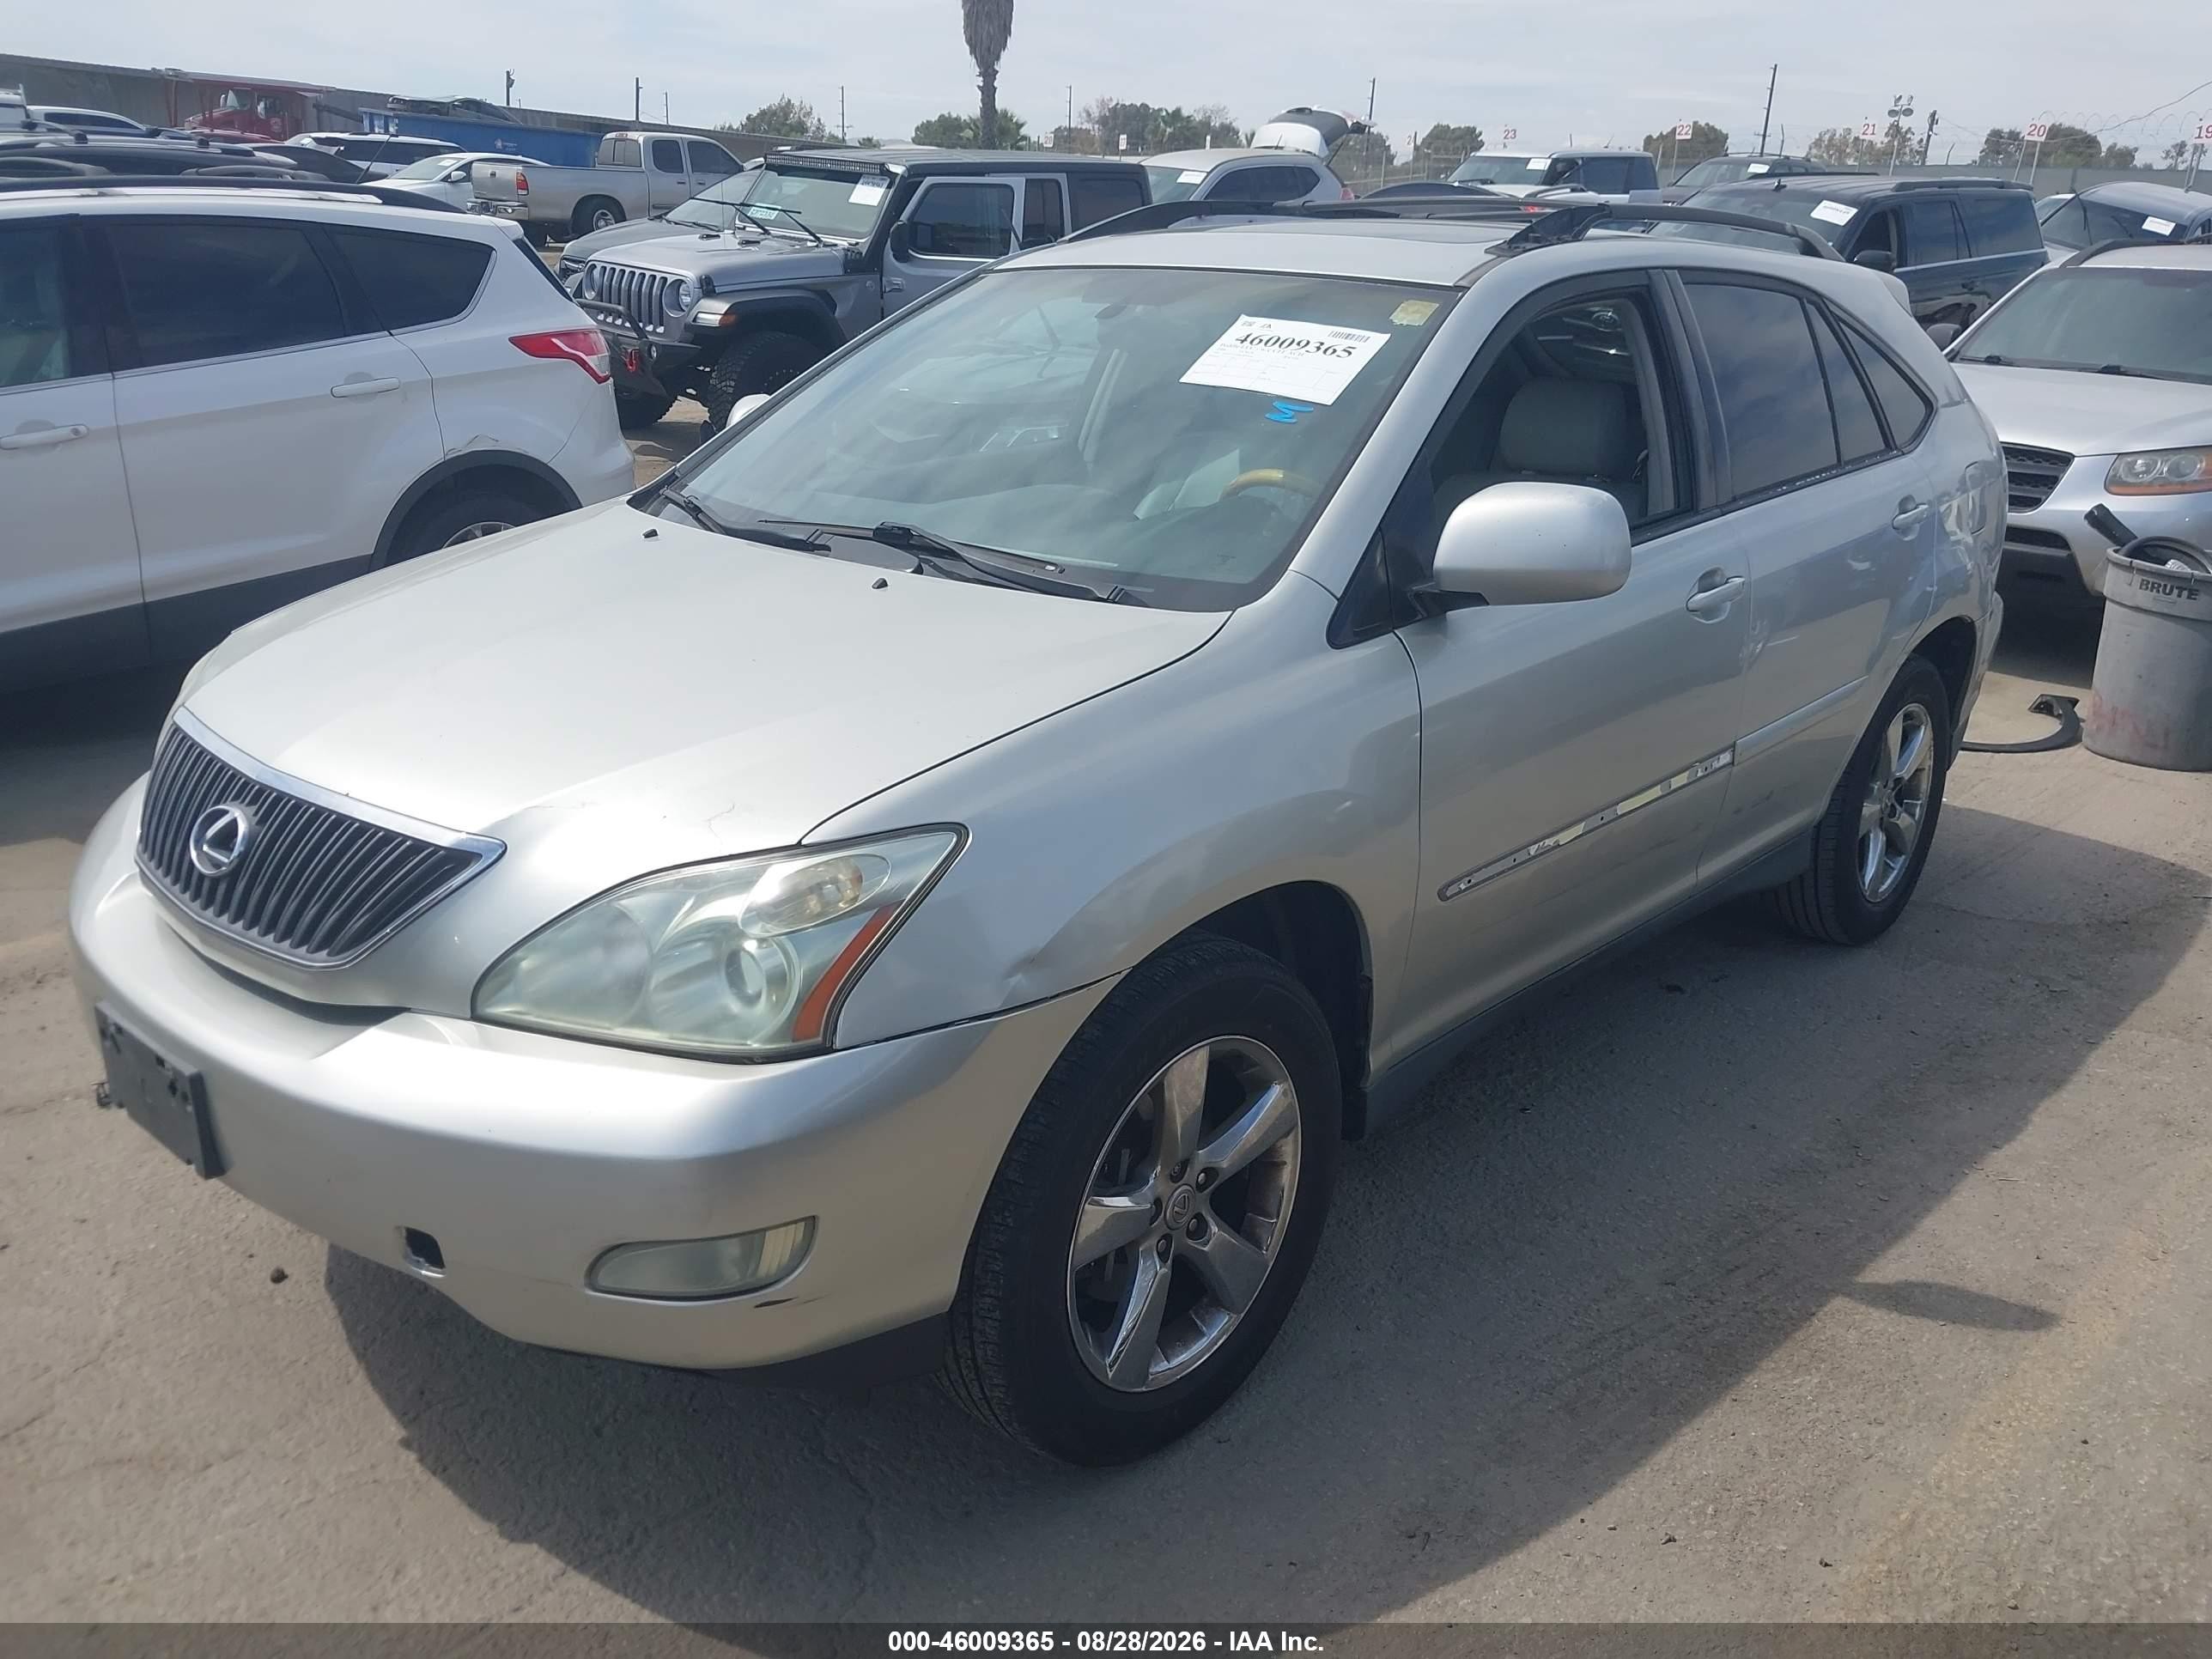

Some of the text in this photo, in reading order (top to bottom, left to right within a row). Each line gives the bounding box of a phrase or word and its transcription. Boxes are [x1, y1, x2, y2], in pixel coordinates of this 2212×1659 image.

[1504, 129, 1516, 139] 23
[1677, 125, 1692, 136] 22
[1862, 124, 1876, 136] 21
[2027, 124, 2047, 137] 20
[2195, 125, 2212, 139] 19
[1235, 332, 1358, 359] 46009365
[2139, 578, 2200, 600] BRUTE
